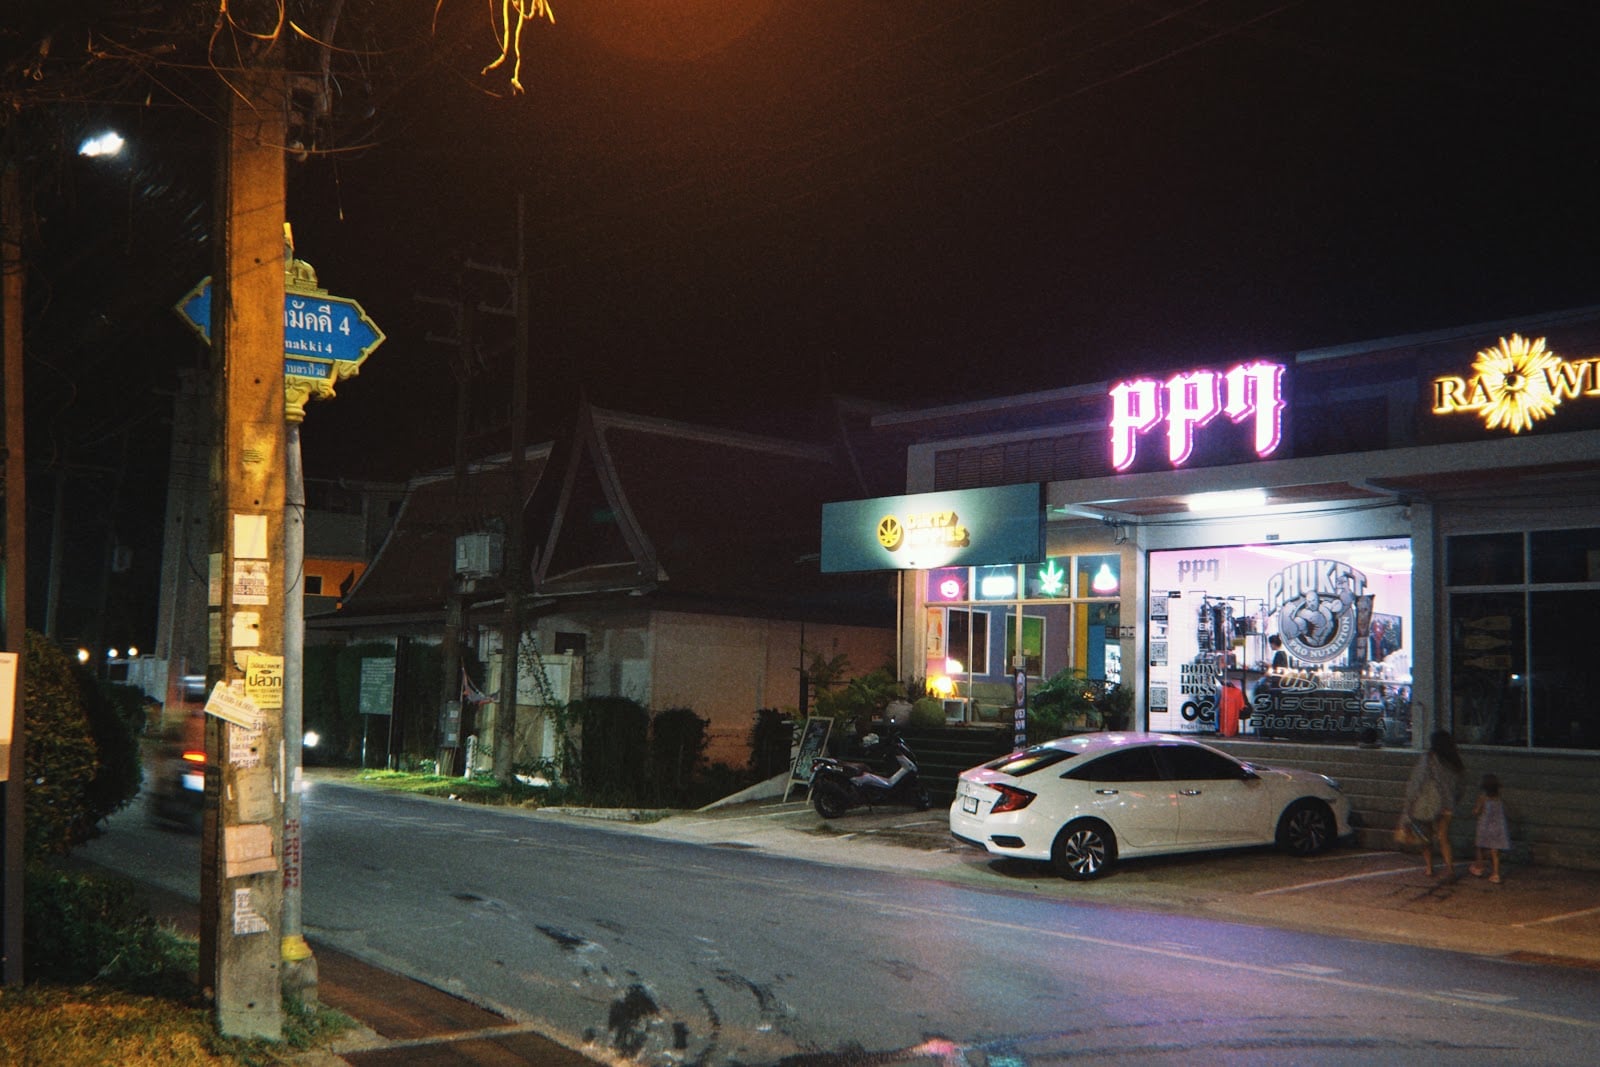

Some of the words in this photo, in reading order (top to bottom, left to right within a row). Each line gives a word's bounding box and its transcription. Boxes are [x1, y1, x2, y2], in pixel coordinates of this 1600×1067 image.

[339, 316, 350, 336] 4
[325, 343, 333, 354] 4
[1267, 558, 1368, 616] PHUKET
[1289, 640, 1308, 656] PRO
[1310, 616, 1350, 658] NUTRITION
[1180, 664, 1215, 674] BODY
[248, 673, 282, 687] ปลวก
[1180, 685, 1216, 695] BOSS
[1180, 701, 1216, 722] OG
